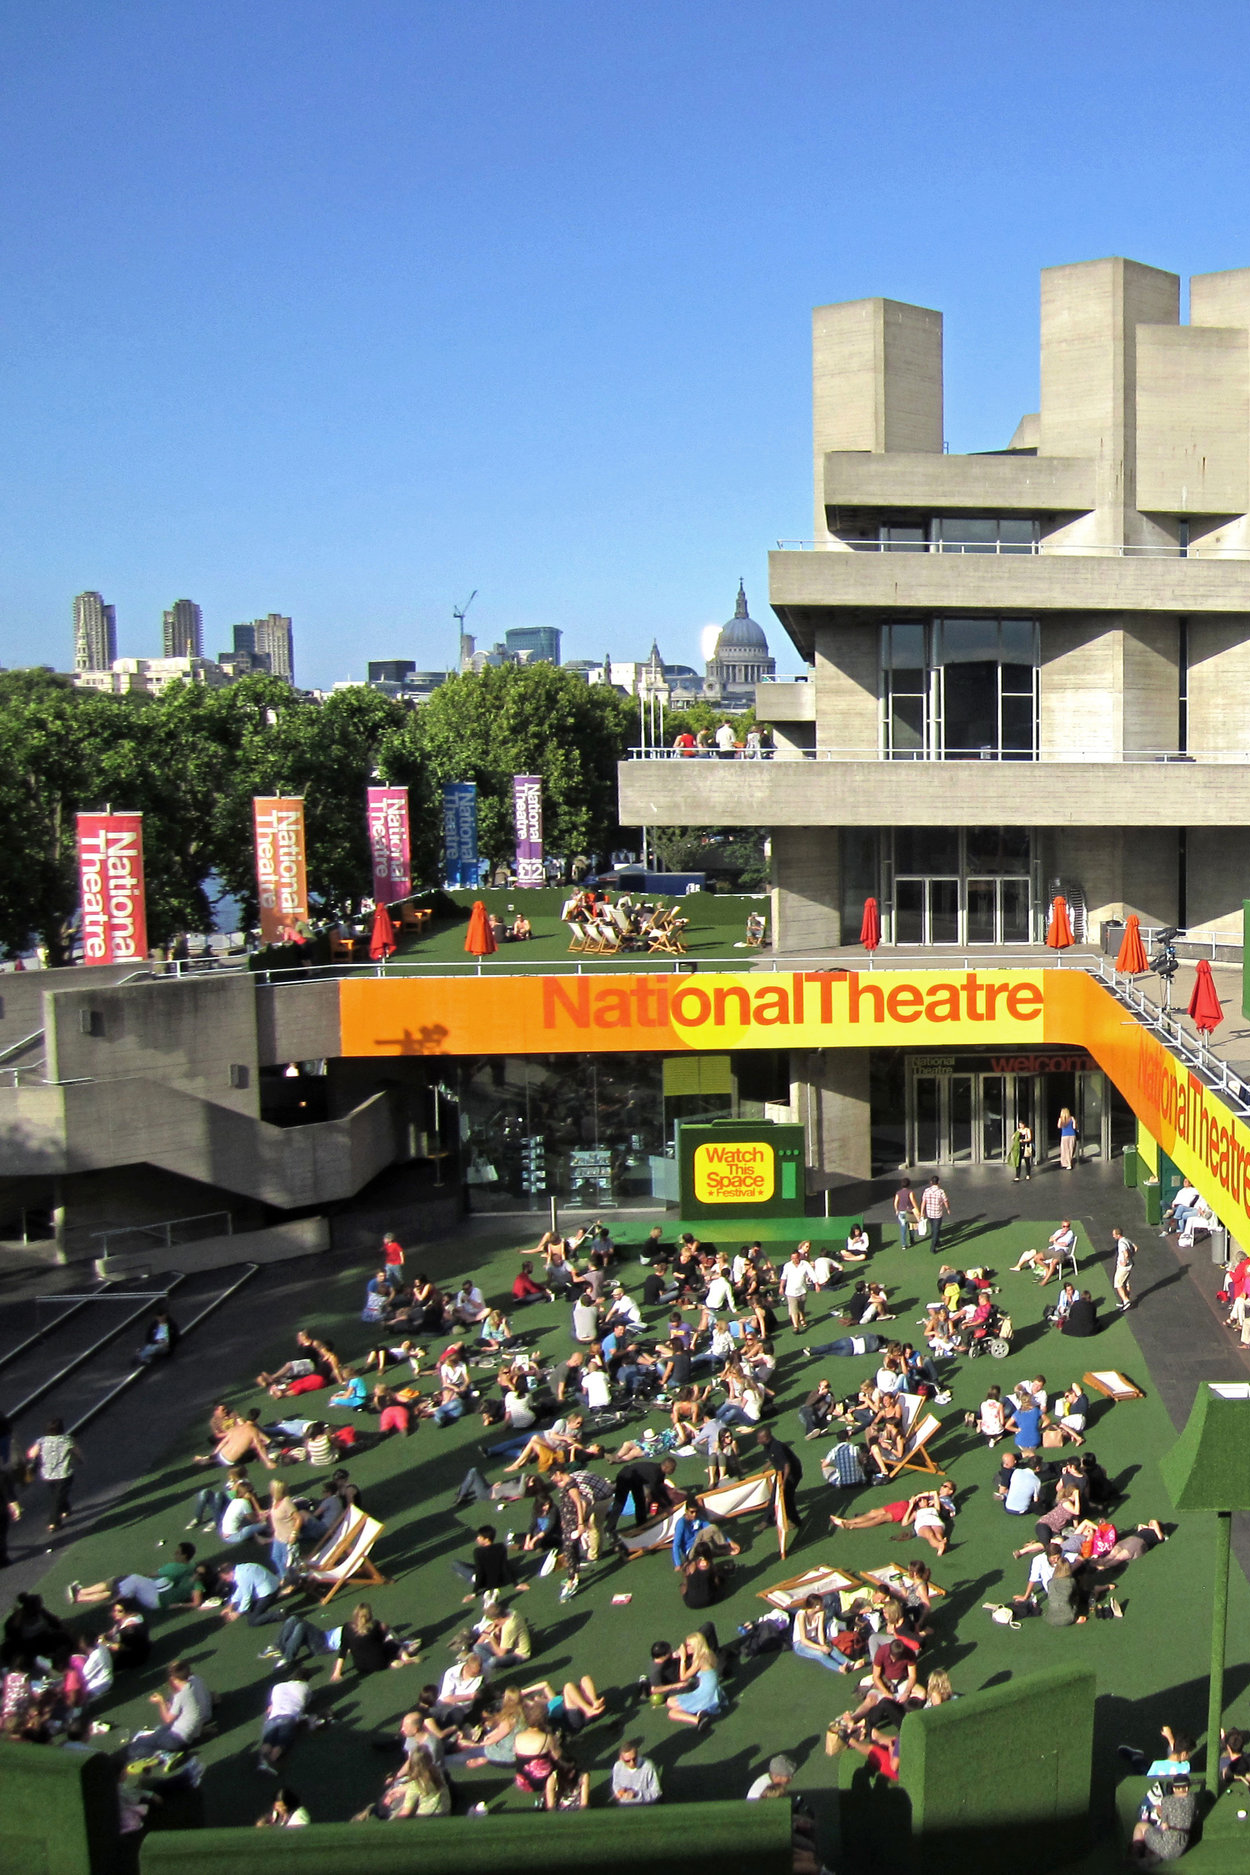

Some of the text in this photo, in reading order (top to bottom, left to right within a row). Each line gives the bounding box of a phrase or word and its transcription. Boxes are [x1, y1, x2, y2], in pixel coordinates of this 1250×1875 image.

[370, 798, 389, 877] Theatre
[386, 799, 408, 881] National
[444, 792, 460, 859] Theatre
[460, 791, 477, 862] National
[515, 783, 528, 839] Theatre
[527, 783, 542, 842] National
[257, 810, 279, 908] Theatre
[278, 811, 304, 913] National
[81, 829, 108, 958] Theatre
[106, 831, 143, 963] National
[912, 1057, 954, 1066] National
[912, 1066, 953, 1075] Theatre
[705, 1147, 764, 1163] Watch
[706, 1172, 764, 1189] Space
[726, 1163, 755, 1175] This
[716, 1188, 756, 1198] Festival
